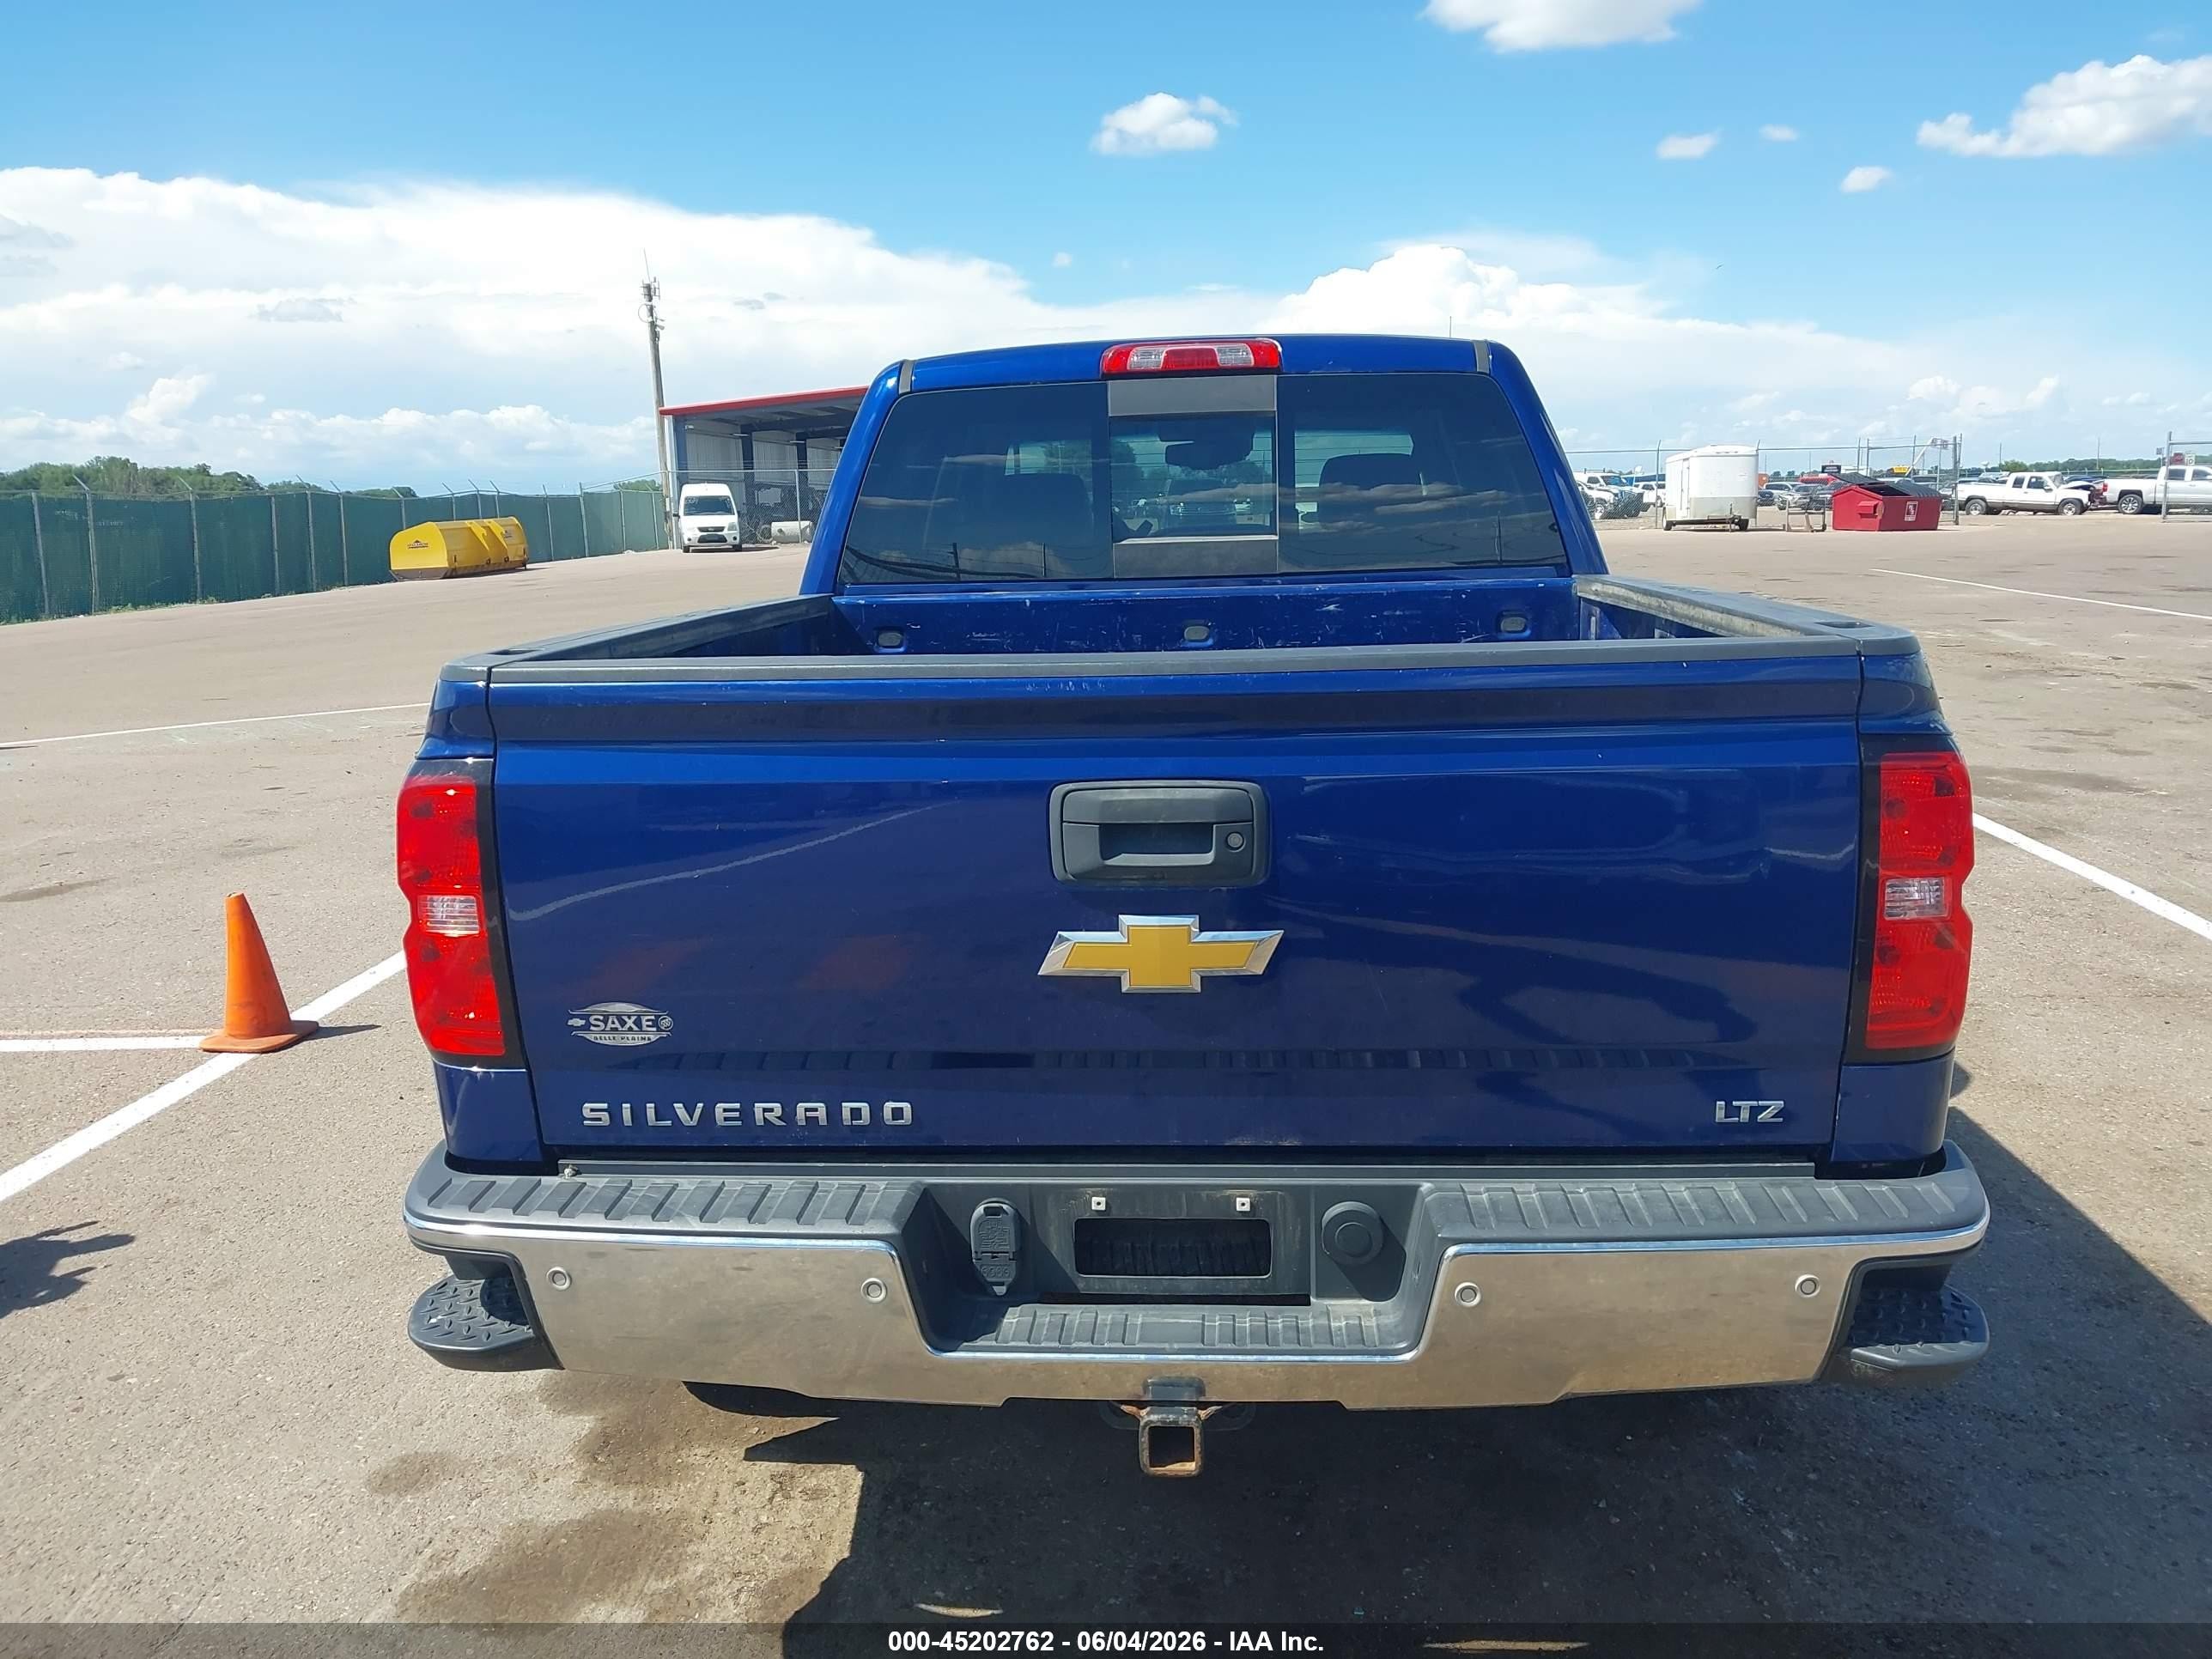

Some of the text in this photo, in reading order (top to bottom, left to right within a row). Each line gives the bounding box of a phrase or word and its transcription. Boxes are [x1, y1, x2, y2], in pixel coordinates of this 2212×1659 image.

[589, 1015, 657, 1030] SAXE
[582, 1103, 912, 1126] SILVERADO
[1716, 1101, 1784, 1122] LTZ
